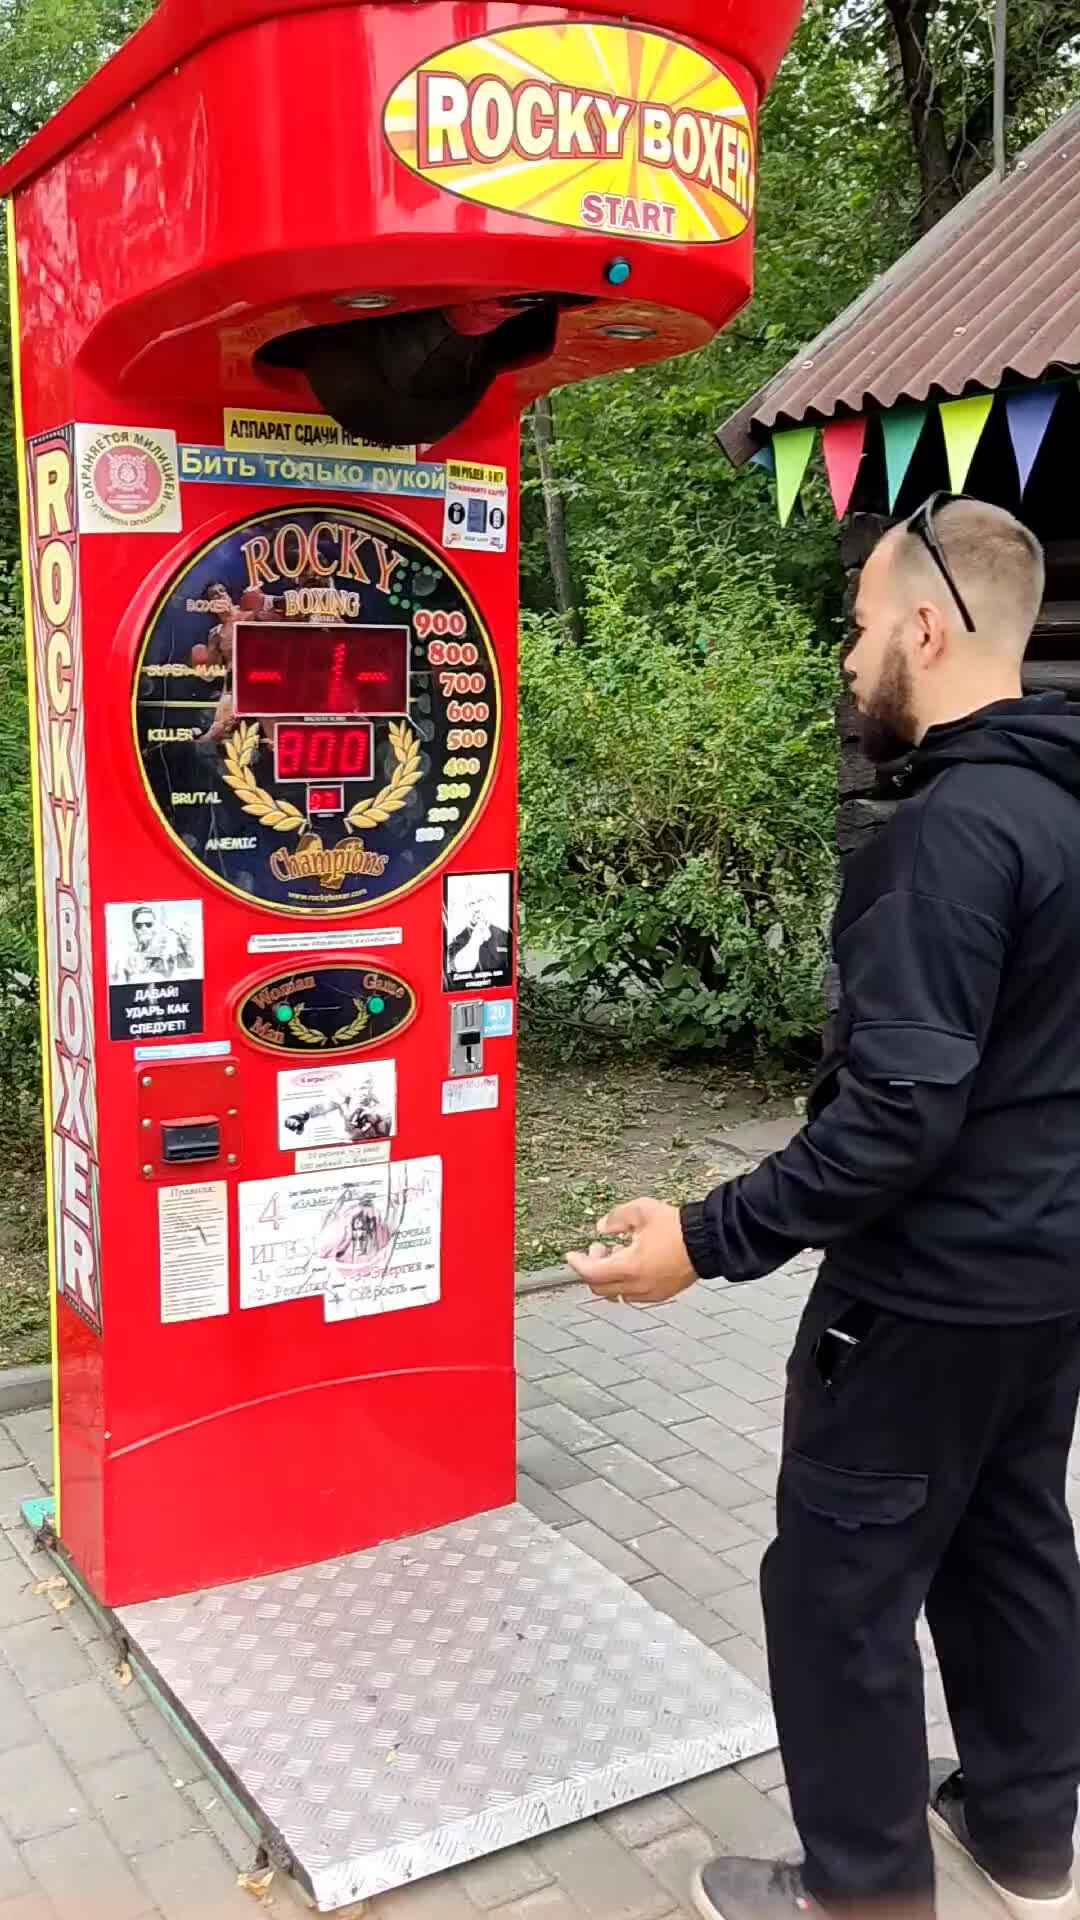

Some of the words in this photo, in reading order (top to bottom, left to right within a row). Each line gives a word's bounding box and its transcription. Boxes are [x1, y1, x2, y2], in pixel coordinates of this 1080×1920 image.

[418, 71, 636, 170] ROCKY
[638, 101, 753, 212] BOXER
[582, 194, 676, 235] START
[230, 419, 291, 441] АППАРАТ
[295, 424, 339, 445] СДАЧИ
[81, 431, 129, 499] ОХРАНЯЕТСЯ
[133, 433, 175, 501] МИЛИЦИЕЙ
[181, 448, 256, 476] Бить
[264, 459, 364, 483] только
[371, 466, 445, 492] рукой
[240, 521, 408, 594] ROCKY
[284, 588, 360, 617] BOXING
[413, 610, 467, 636] 900
[34, 447, 80, 883] ROCKY
[428, 640, 478, 665] 800
[440, 672, 486, 696] 700
[447, 701, 489, 722] 600
[148, 729, 193, 742] KILLER
[447, 729, 488, 750] 500
[443, 757, 481, 777] 400
[171, 792, 222, 805] BRUTAL
[437, 783, 471, 801] 300
[206, 837, 257, 850] ANEMIC
[270, 847, 390, 881] Champions
[134, 986, 180, 1002] ДАВАЙ!
[252, 975, 317, 1009] Woman
[362, 973, 404, 999] Game
[125, 1005, 164, 1019] УДАРЬ
[167, 1003, 190, 1014] КАК
[489, 1005, 505, 1020] 20
[129, 1020, 186, 1034] СЛЕДУЕТ!
[250, 1016, 285, 1044] Man
[53, 880, 100, 1318] BOXER
[258, 1192, 286, 1231] 4
